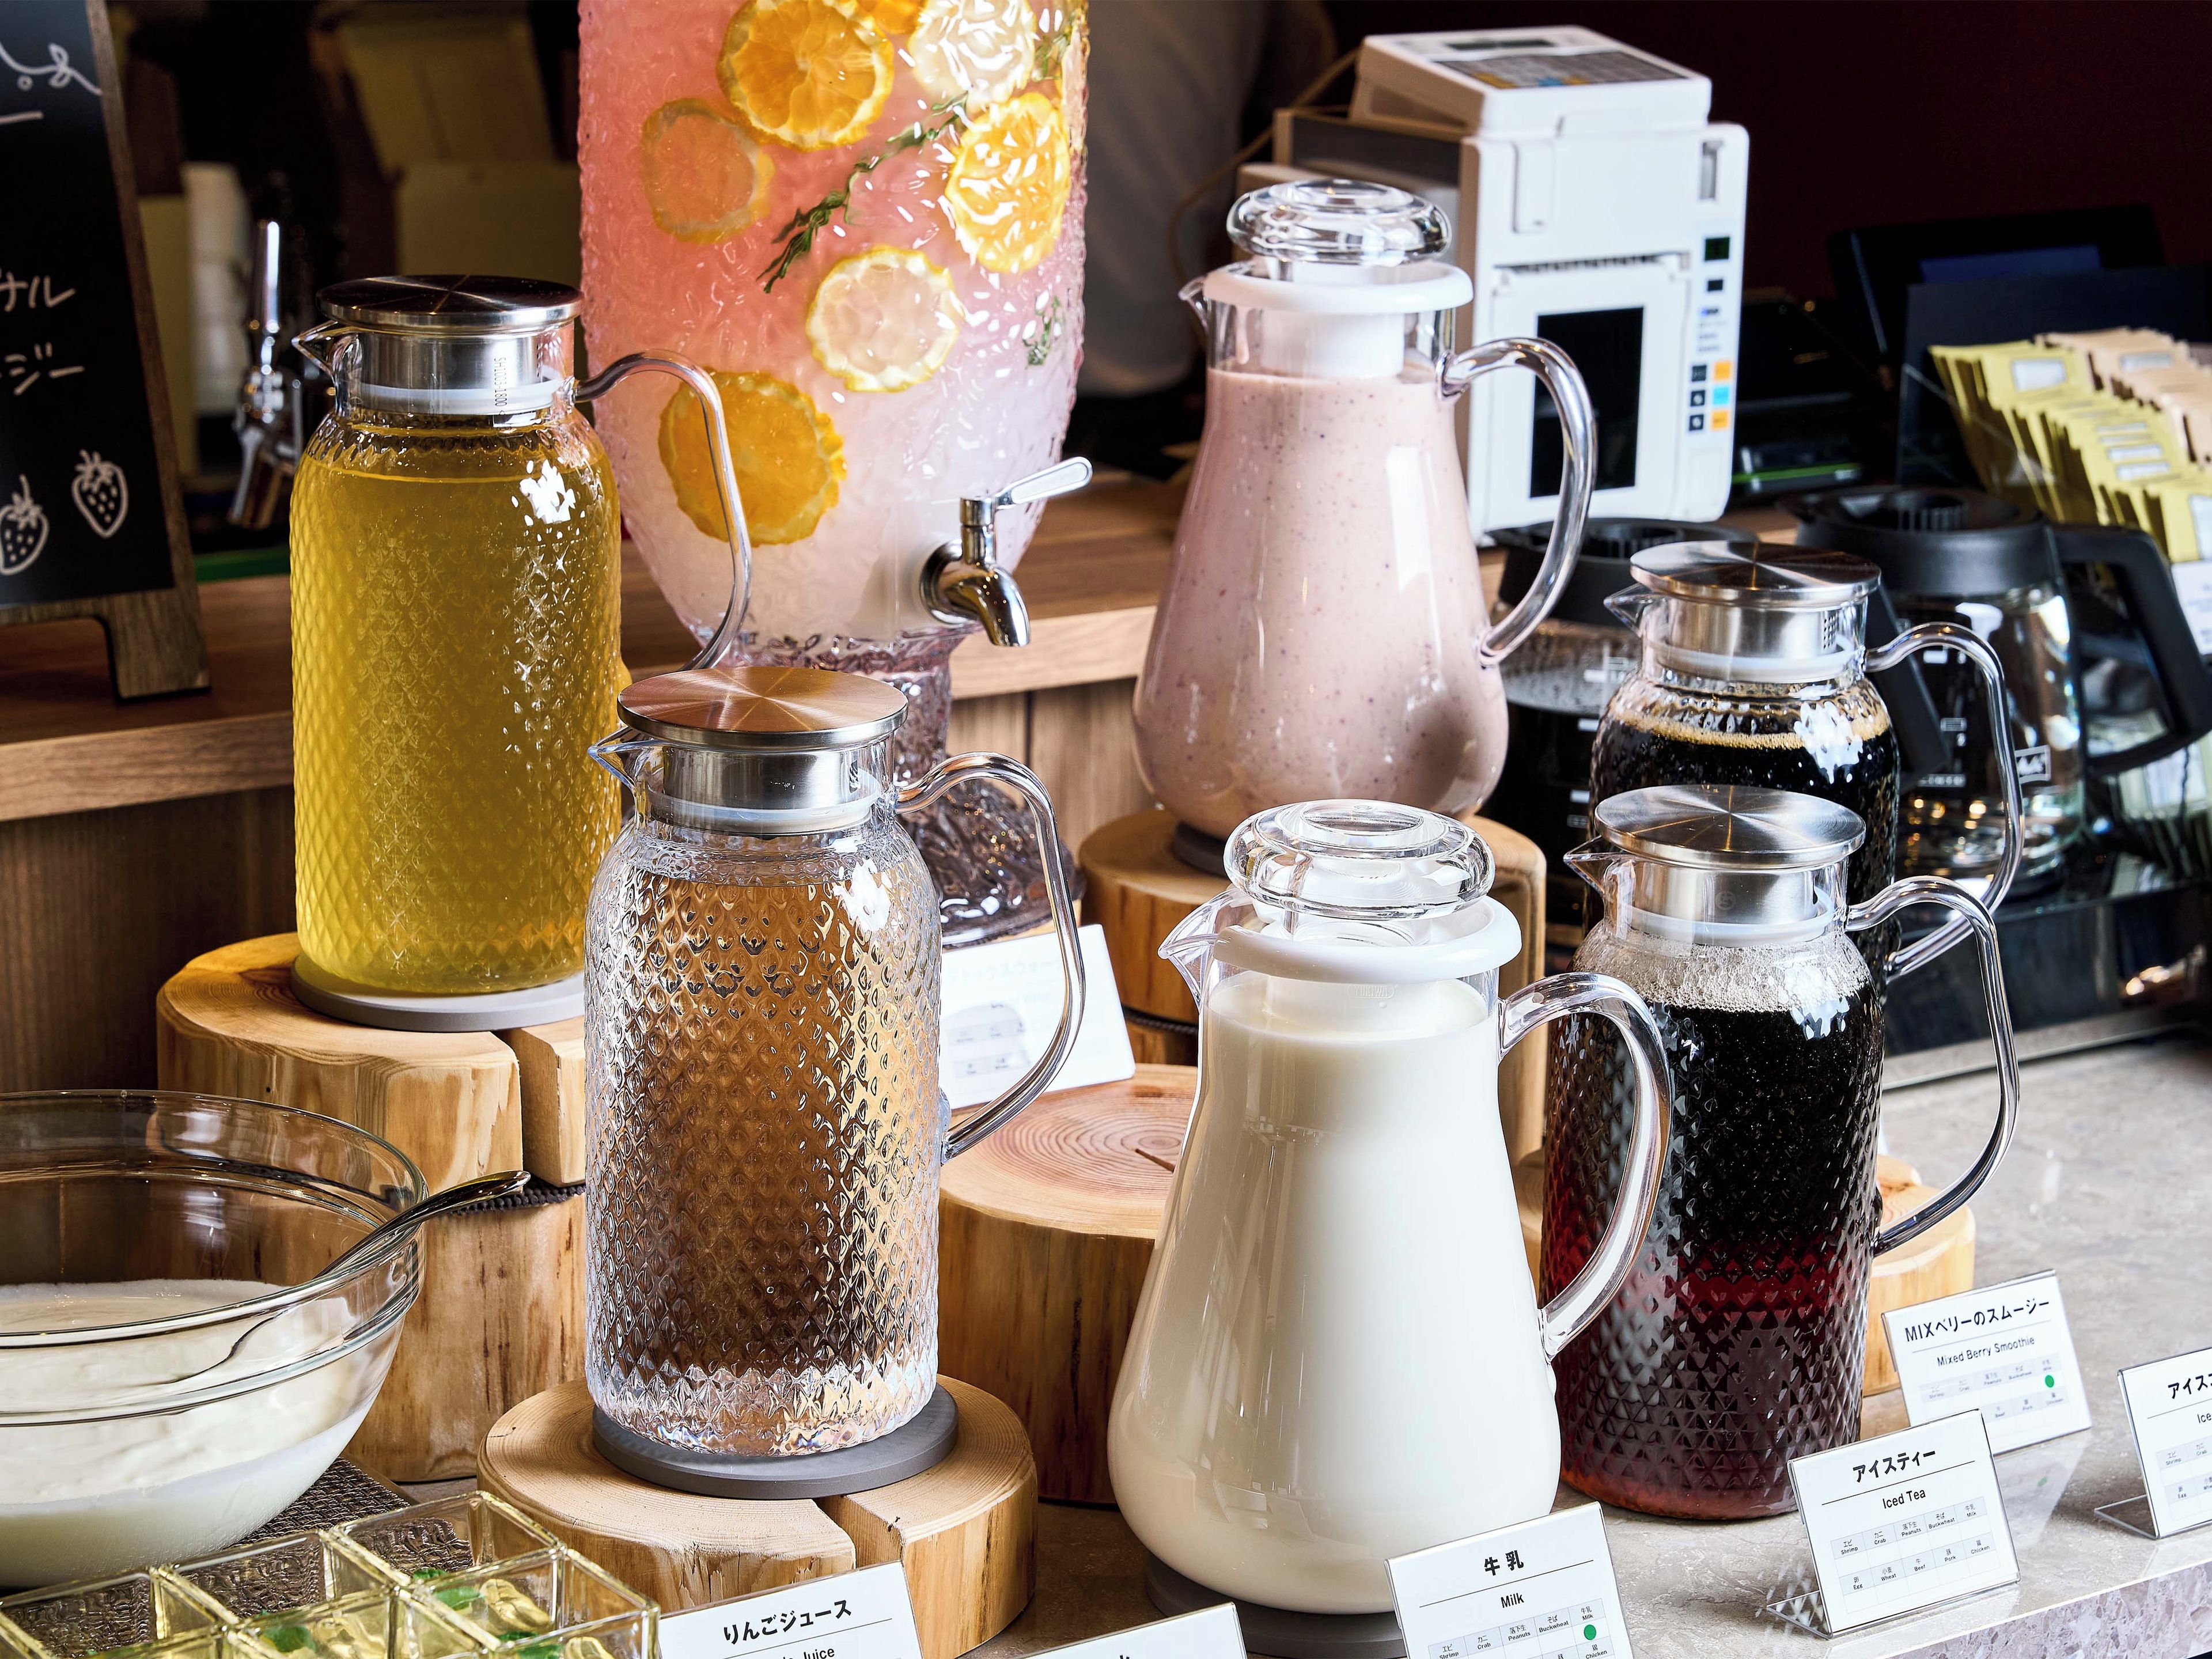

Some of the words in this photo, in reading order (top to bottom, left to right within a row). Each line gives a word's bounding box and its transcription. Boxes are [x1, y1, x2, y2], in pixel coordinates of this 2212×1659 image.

[0, 271, 77, 312] ナル
[0, 342, 85, 395] ジー
[1905, 1298, 2049, 1342] MIXベリーのスムージー
[1937, 1351, 1964, 1366] Mixed
[1966, 1346, 1991, 1361] Berry
[1994, 1335, 2035, 1353] Smoothie
[2197, 1412, 2212, 1423] Ice
[1853, 1450, 1936, 1483] アイスティー
[1883, 1494, 1905, 1509] Iced
[1906, 1488, 1926, 1502] Tea
[1928, 1517, 1955, 1529] Buckwheat
[1901, 1527, 1922, 1537] Peanuts
[1840, 1546, 1858, 1555] Shrimp
[1971, 1545, 1990, 1555] Chicken
[1483, 1550, 1524, 1576] 牛乳
[1914, 1564, 1926, 1572] Beef
[1880, 1573, 1897, 1582] Wheat
[1500, 1592, 1525, 1608] Milk
[724, 1599, 852, 1645] りんごジュース
[1539, 1620, 1569, 1633] Buckwheat
[1508, 1631, 1531, 1642] Peanuts
[1439, 1651, 1459, 1659] Shrimp
[1585, 1650, 1608, 1659] Chicken
